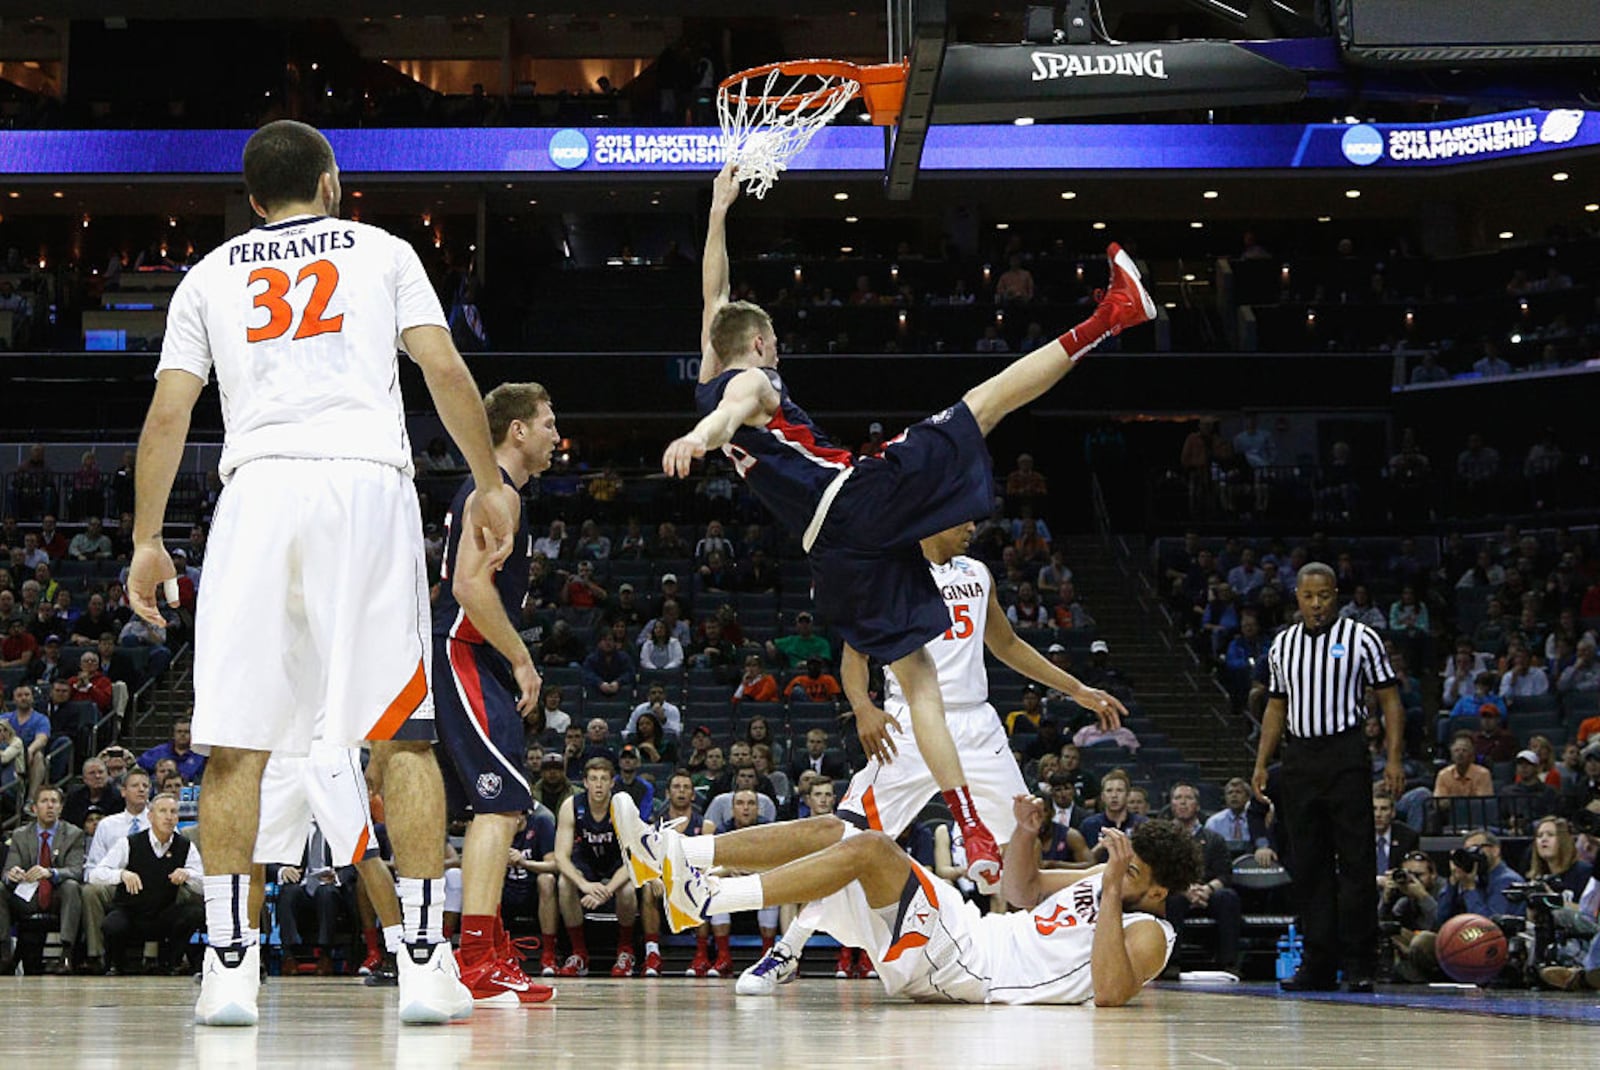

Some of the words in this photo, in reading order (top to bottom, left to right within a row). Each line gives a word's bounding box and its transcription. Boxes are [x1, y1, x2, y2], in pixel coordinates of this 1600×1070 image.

[1031, 49, 1168, 80] SPALDING
[595, 135, 632, 148] 2015
[635, 135, 729, 149] BASKETBAL
[1389, 130, 1427, 146] 2015
[1429, 117, 1537, 142] BASKETBALL
[1390, 131, 1537, 160] CHAMPIONSHIP
[595, 148, 729, 163] CHAMPIONSHI
[229, 230, 355, 266] PERRANTES
[246, 259, 344, 343] 32
